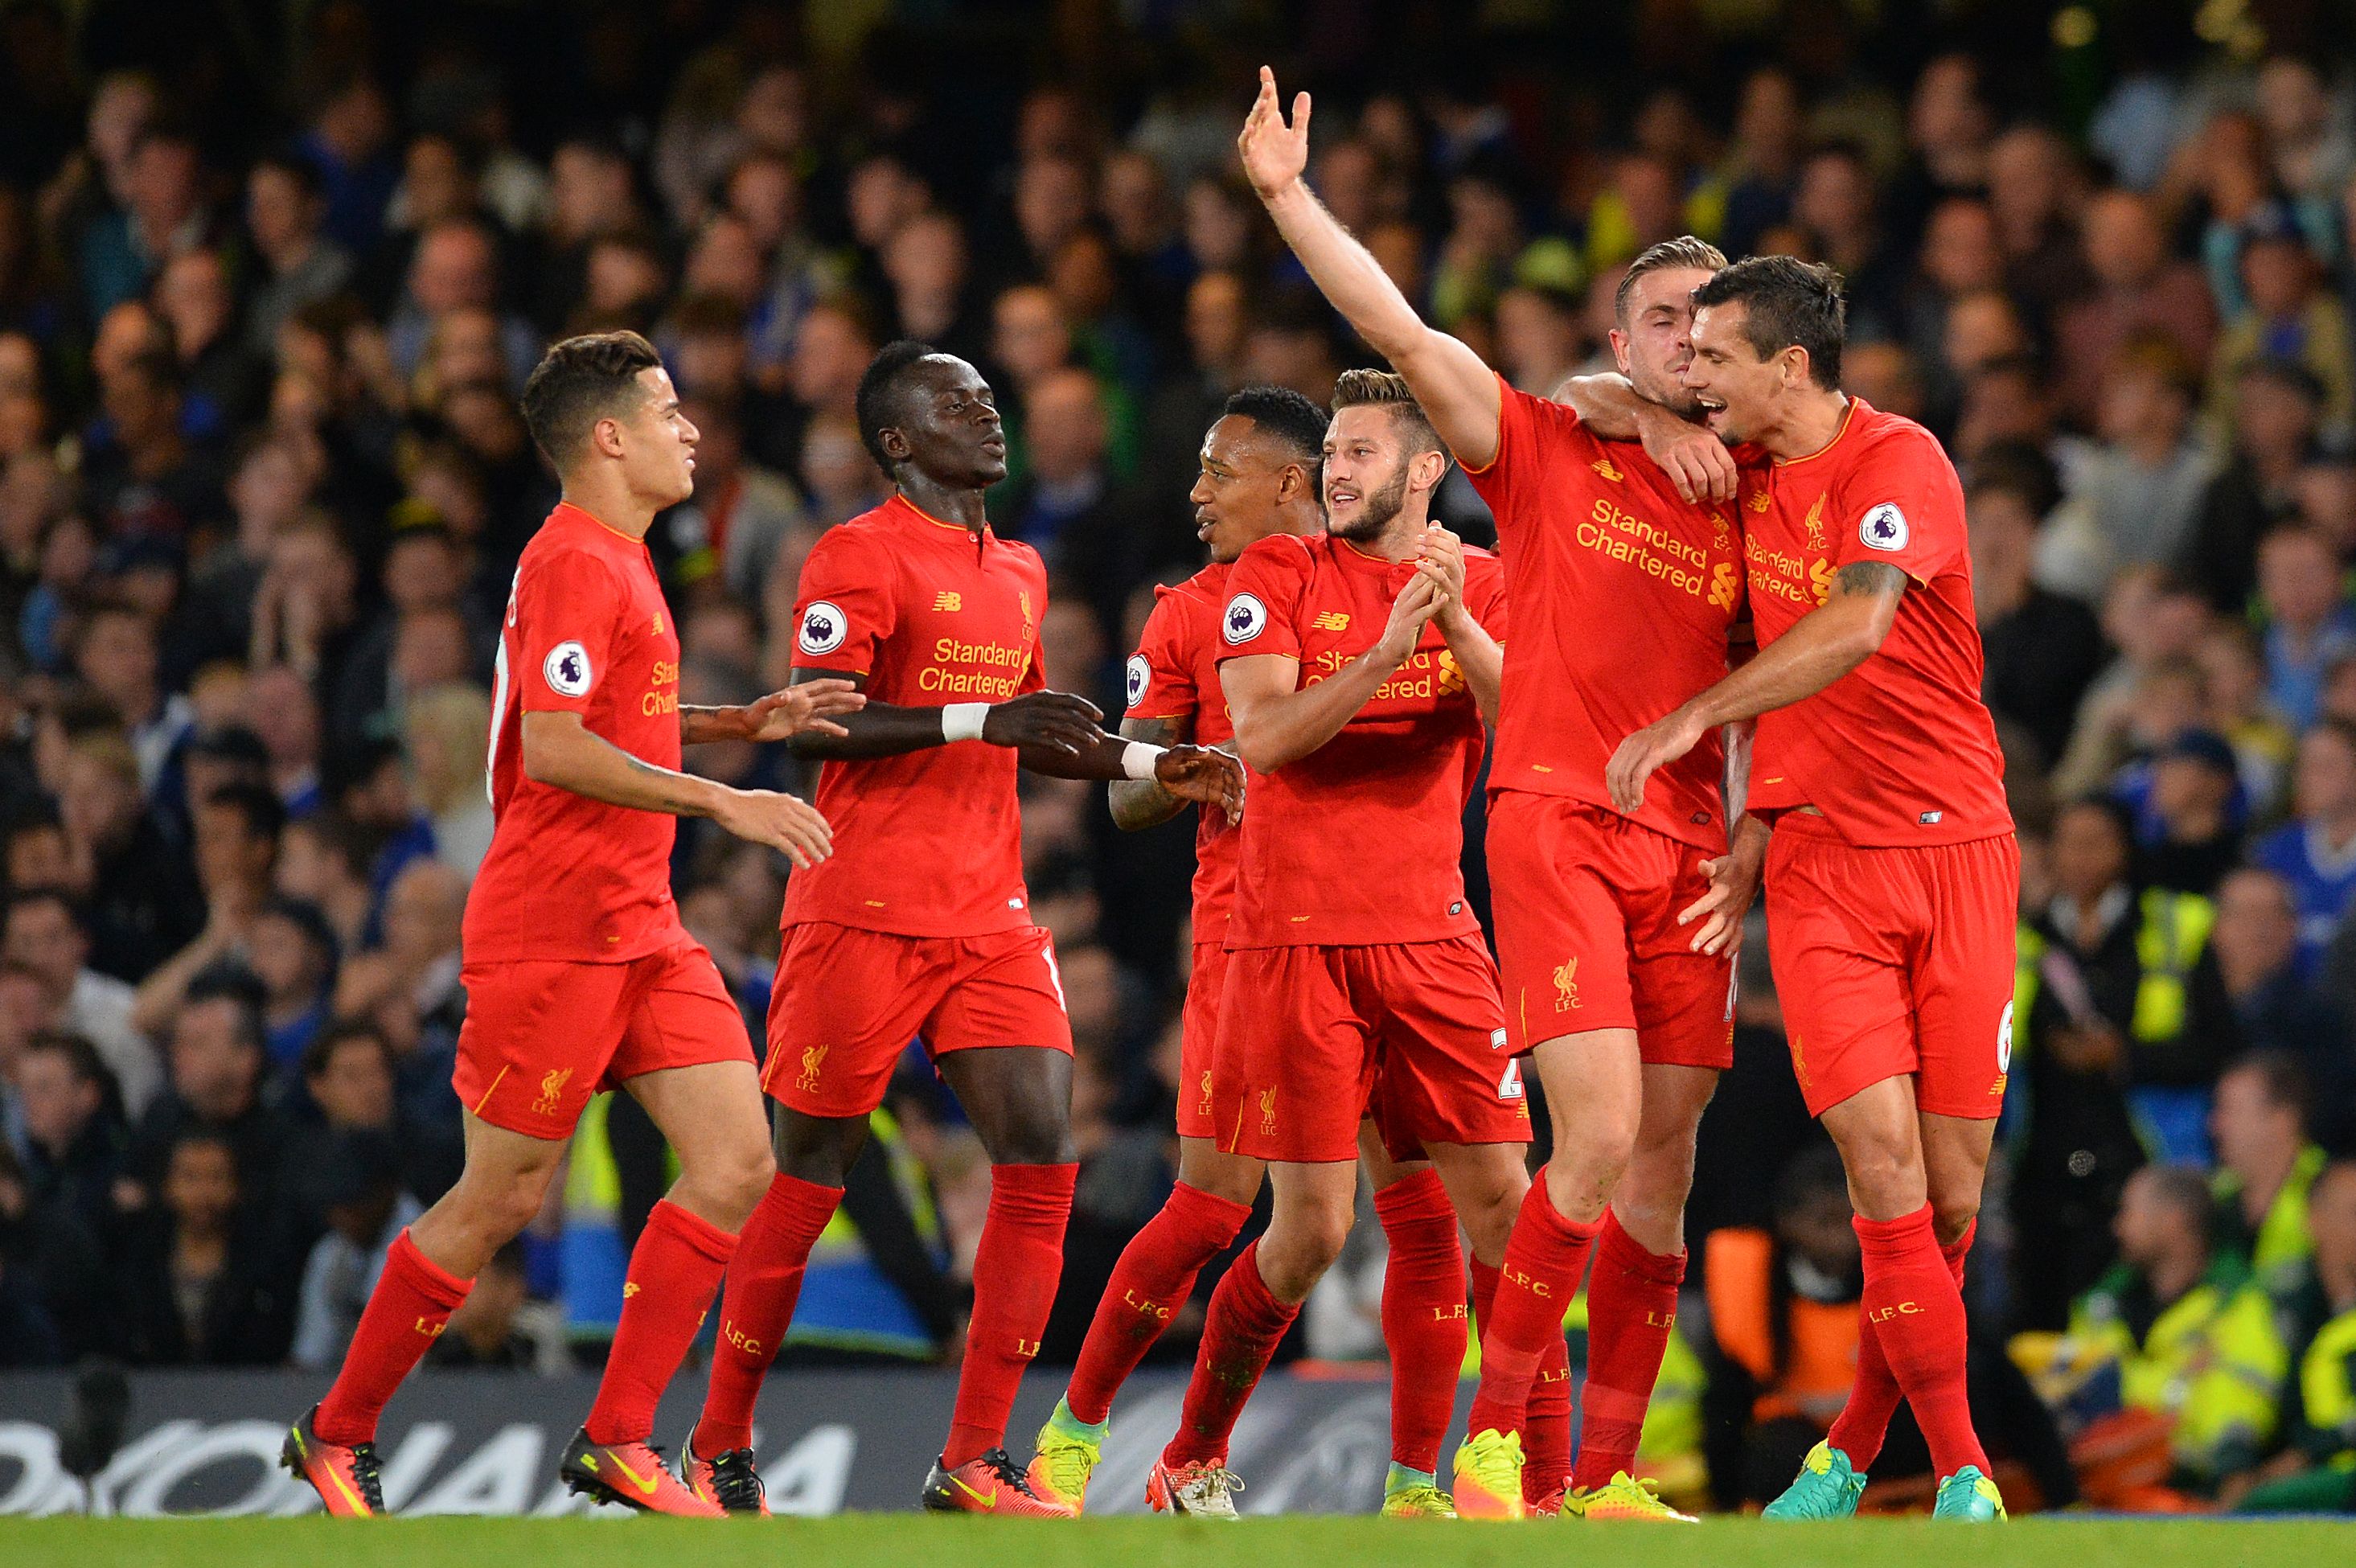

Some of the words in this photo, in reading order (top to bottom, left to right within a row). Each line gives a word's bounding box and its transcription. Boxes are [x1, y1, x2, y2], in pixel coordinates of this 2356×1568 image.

[1591, 499, 1707, 569] Standard
[1576, 522, 1704, 597] Chartered
[934, 638, 1022, 669] Standard
[918, 667, 1018, 698] Chartered
